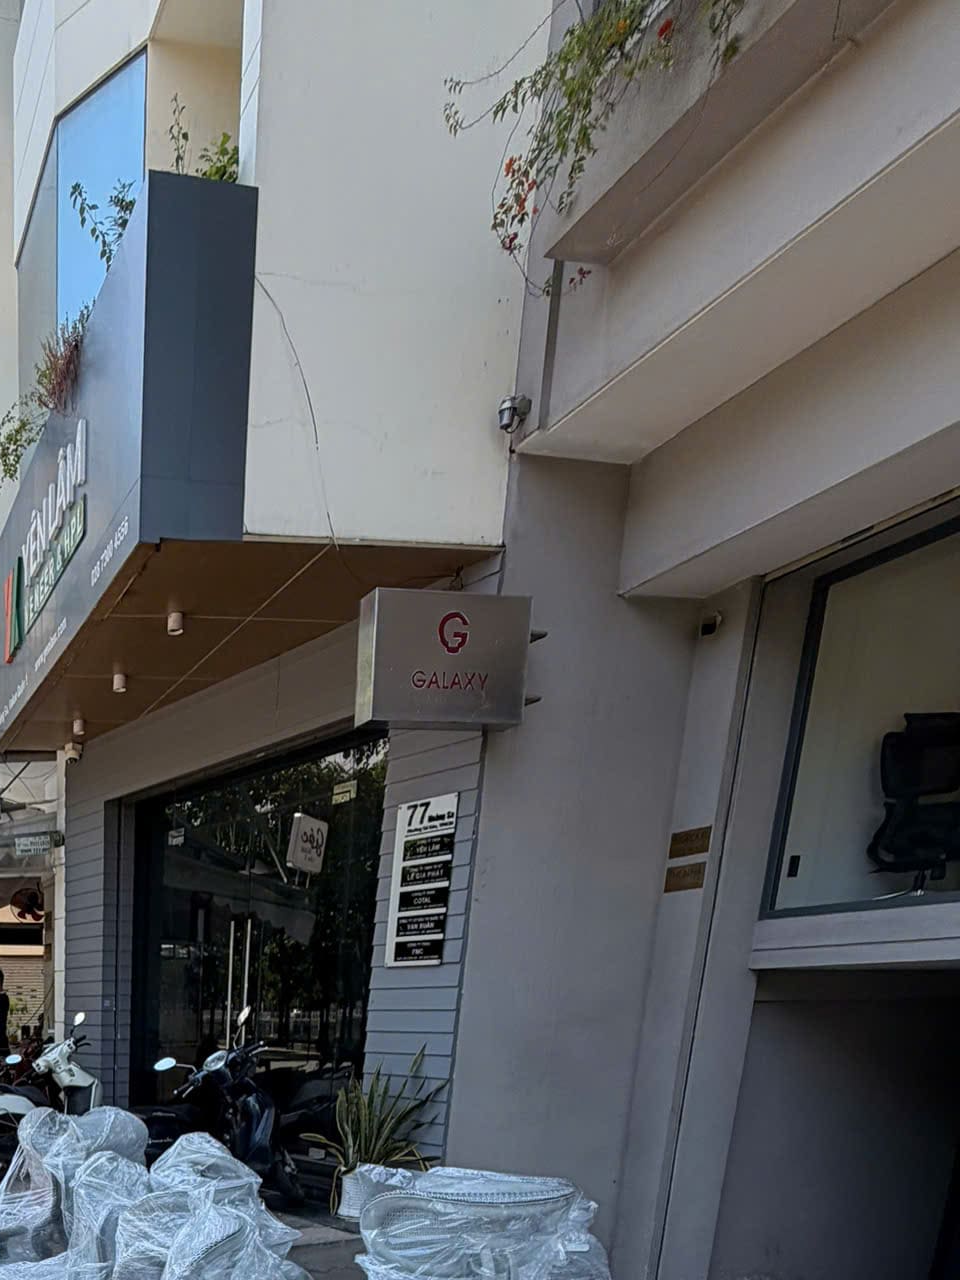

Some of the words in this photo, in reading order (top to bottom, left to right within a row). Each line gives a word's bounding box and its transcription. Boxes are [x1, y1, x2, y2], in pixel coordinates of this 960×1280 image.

[48, 418, 87, 540] LÂM
[63, 508, 84, 557] HPL
[411, 670, 489, 692] GALAXY
[406, 801, 431, 827] 77
